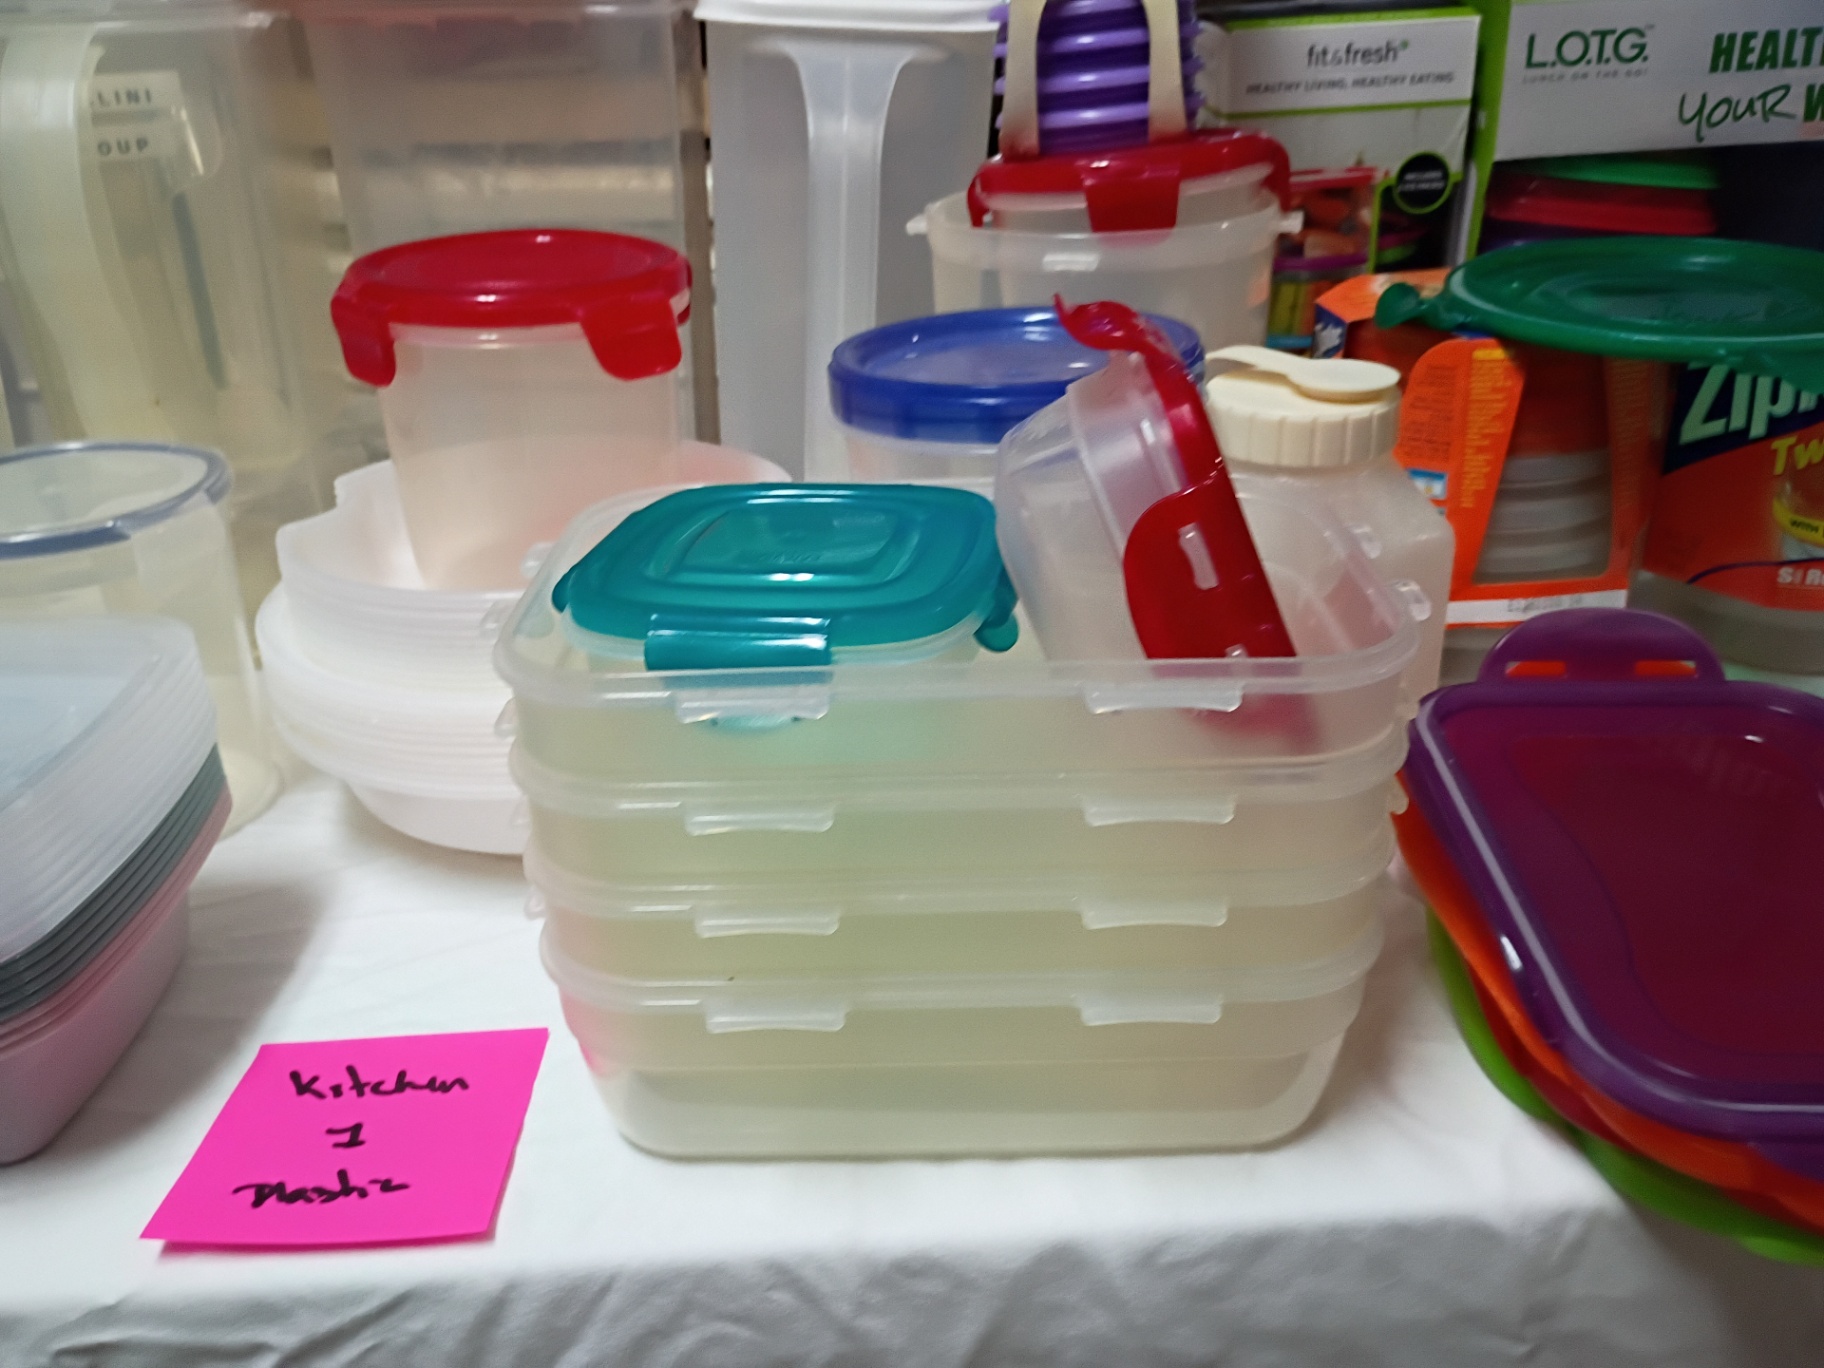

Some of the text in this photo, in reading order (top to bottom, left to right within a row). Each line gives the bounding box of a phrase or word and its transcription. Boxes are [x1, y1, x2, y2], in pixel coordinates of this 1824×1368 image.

[1525, 27, 1649, 69] L.O.T.G.
[1708, 26, 1824, 73] HEALT
[289, 1064, 470, 1100] Kitchen
